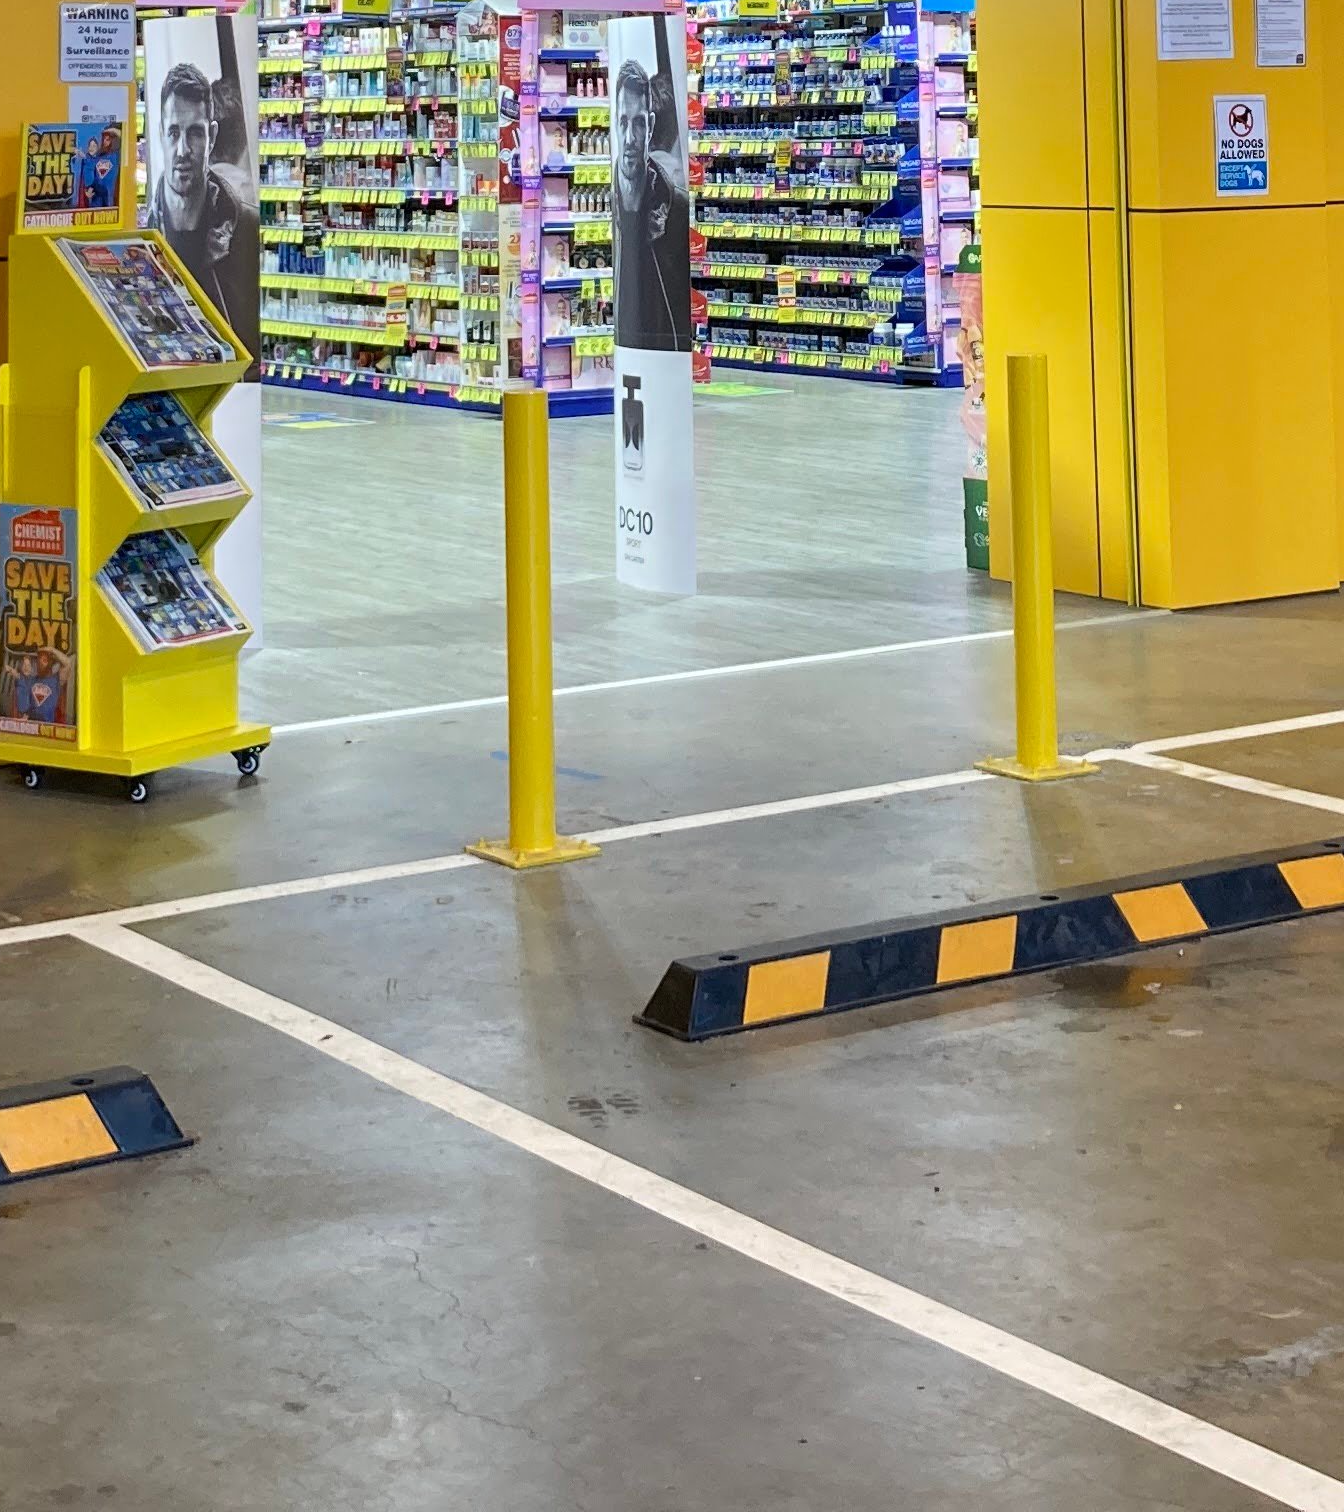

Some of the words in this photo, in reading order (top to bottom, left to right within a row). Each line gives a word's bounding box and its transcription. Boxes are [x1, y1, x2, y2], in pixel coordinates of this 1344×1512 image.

[66, 8, 129, 20] WARNING
[78, 26, 91, 34] 24
[94, 26, 118, 34] Hour
[84, 36, 113, 45] Video
[66, 46, 130, 55] Surveillance
[28, 132, 75, 154] SAVE
[1221, 139, 1235, 149] NO
[1237, 138, 1264, 148] DOGS
[1220, 149, 1265, 159] ALLOWED
[33, 153, 71, 175] THE
[27, 174, 73, 197] DAY!
[25, 212, 73, 229] CATALOGUE
[619, 505, 653, 535] DC10
[14, 523, 61, 541] CHEMIST
[6, 559, 70, 593] SAVE
[13, 589, 64, 621] THE
[8, 617, 68, 651] DAY!
